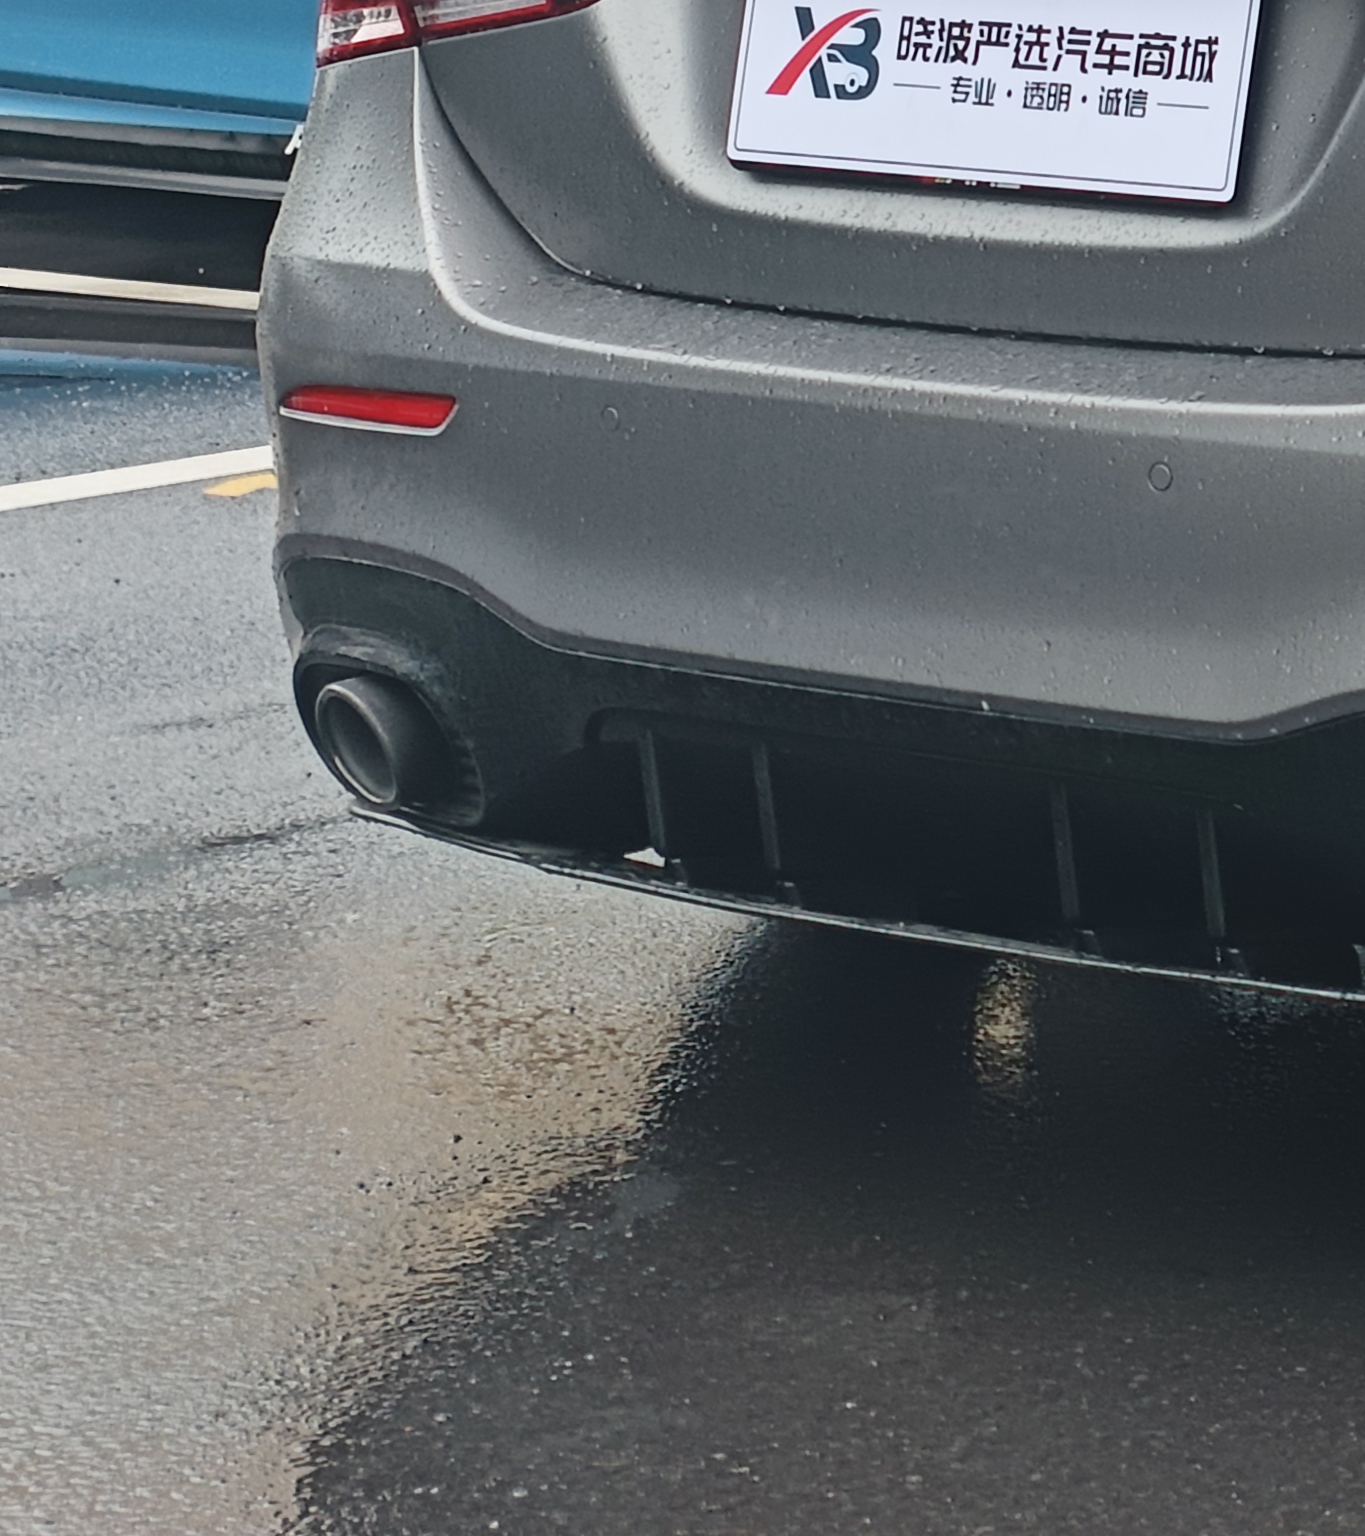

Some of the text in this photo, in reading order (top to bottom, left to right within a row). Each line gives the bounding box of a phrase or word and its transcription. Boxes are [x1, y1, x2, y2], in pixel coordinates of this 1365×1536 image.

[896, 16, 1219, 84] 晓波严选汽车商城
